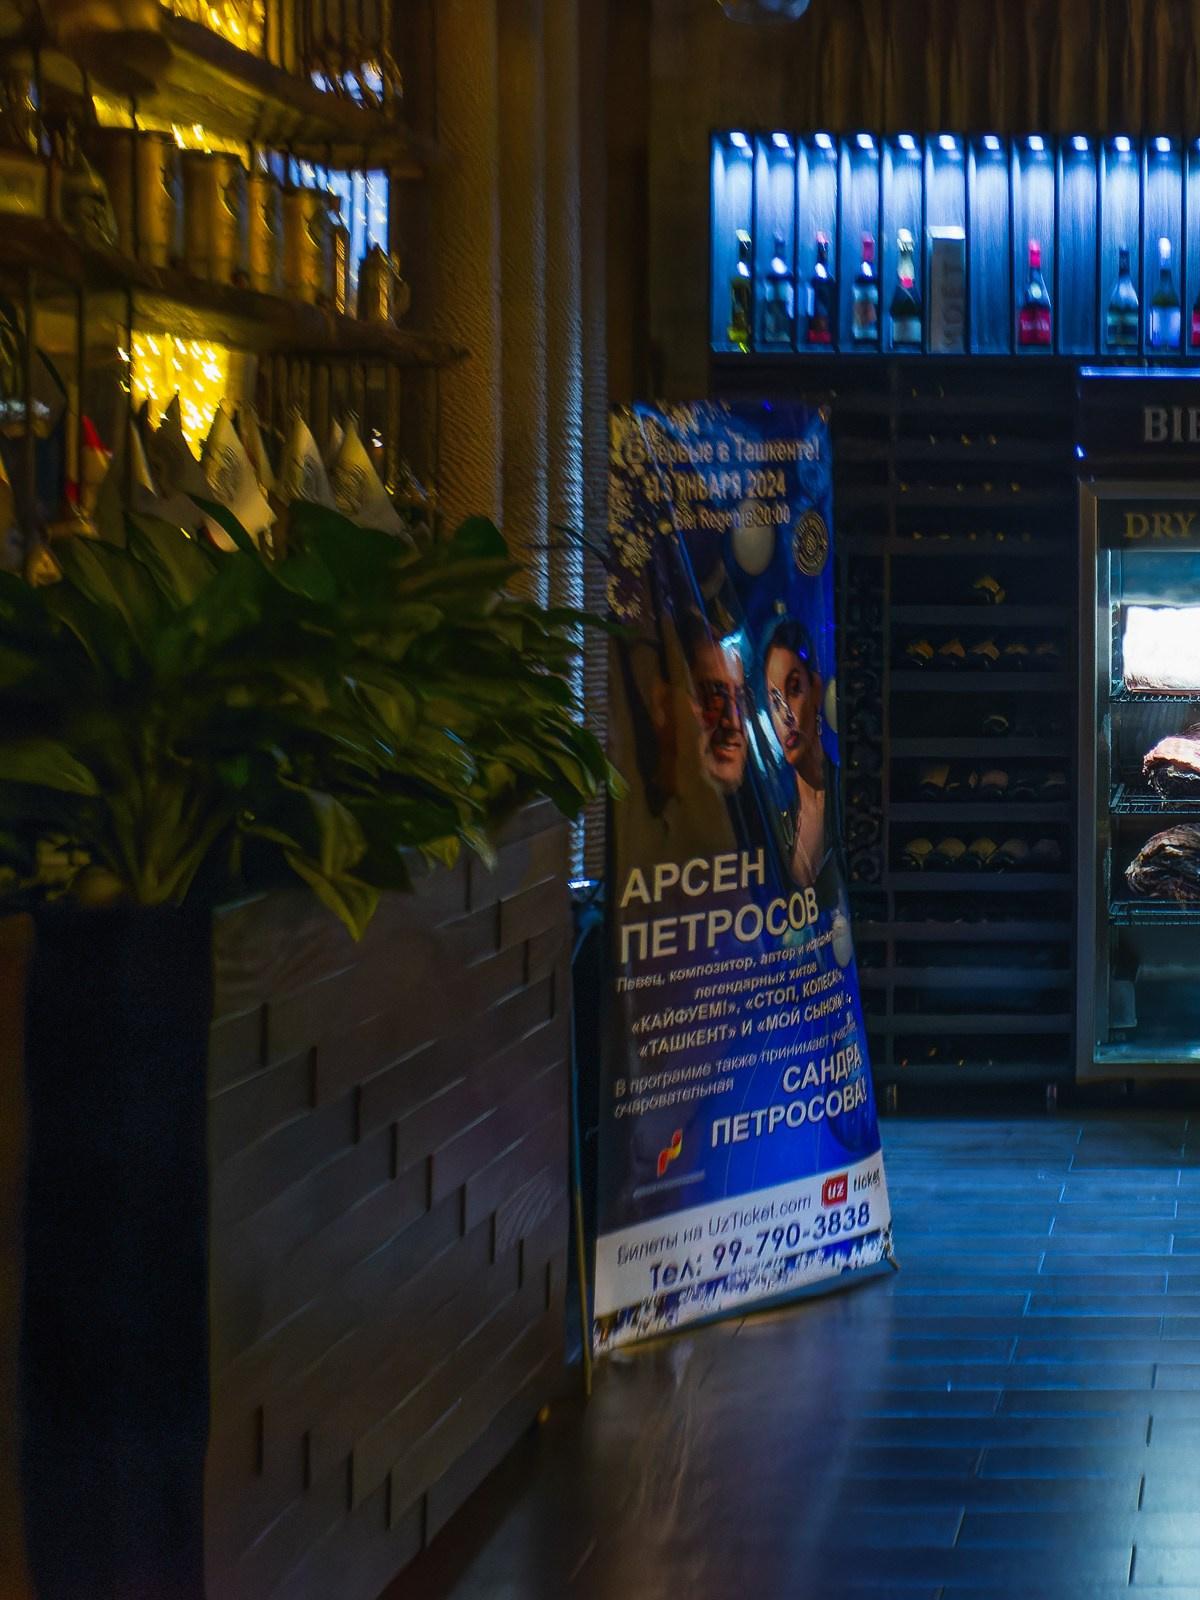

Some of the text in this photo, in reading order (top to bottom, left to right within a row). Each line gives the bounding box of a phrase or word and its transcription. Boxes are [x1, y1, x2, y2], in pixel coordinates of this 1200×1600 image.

[744, 467, 787, 499] 2024
[1124, 511, 1197, 540] DRY
[620, 848, 765, 908] АРСЕН
[620, 887, 820, 965] ПЕТРОСОВ
[616, 973, 666, 994] Певец,
[669, 956, 757, 983] композитор,
[760, 947, 796, 966] автор
[693, 961, 818, 1000] легендарных хитов
[745, 985, 800, 1011] «СТОП,
[639, 1023, 737, 1058] «ТАШКЕНТ»
[741, 1018, 753, 1038] И
[757, 1005, 801, 1034] «МОЙ
[614, 1077, 627, 1099] В
[629, 1061, 713, 1096] программе
[715, 1052, 758, 1075] также
[760, 1034, 830, 1067] принимают
[782, 1040, 863, 1094] САНДРА
[613, 1076, 735, 1120] очаровательная
[711, 1075, 868, 1149] ПЕТРОСОВА!
[617, 1194, 812, 1267] Билеты на UzTicket.com
[712, 1201, 871, 1272] 99-790-3838
